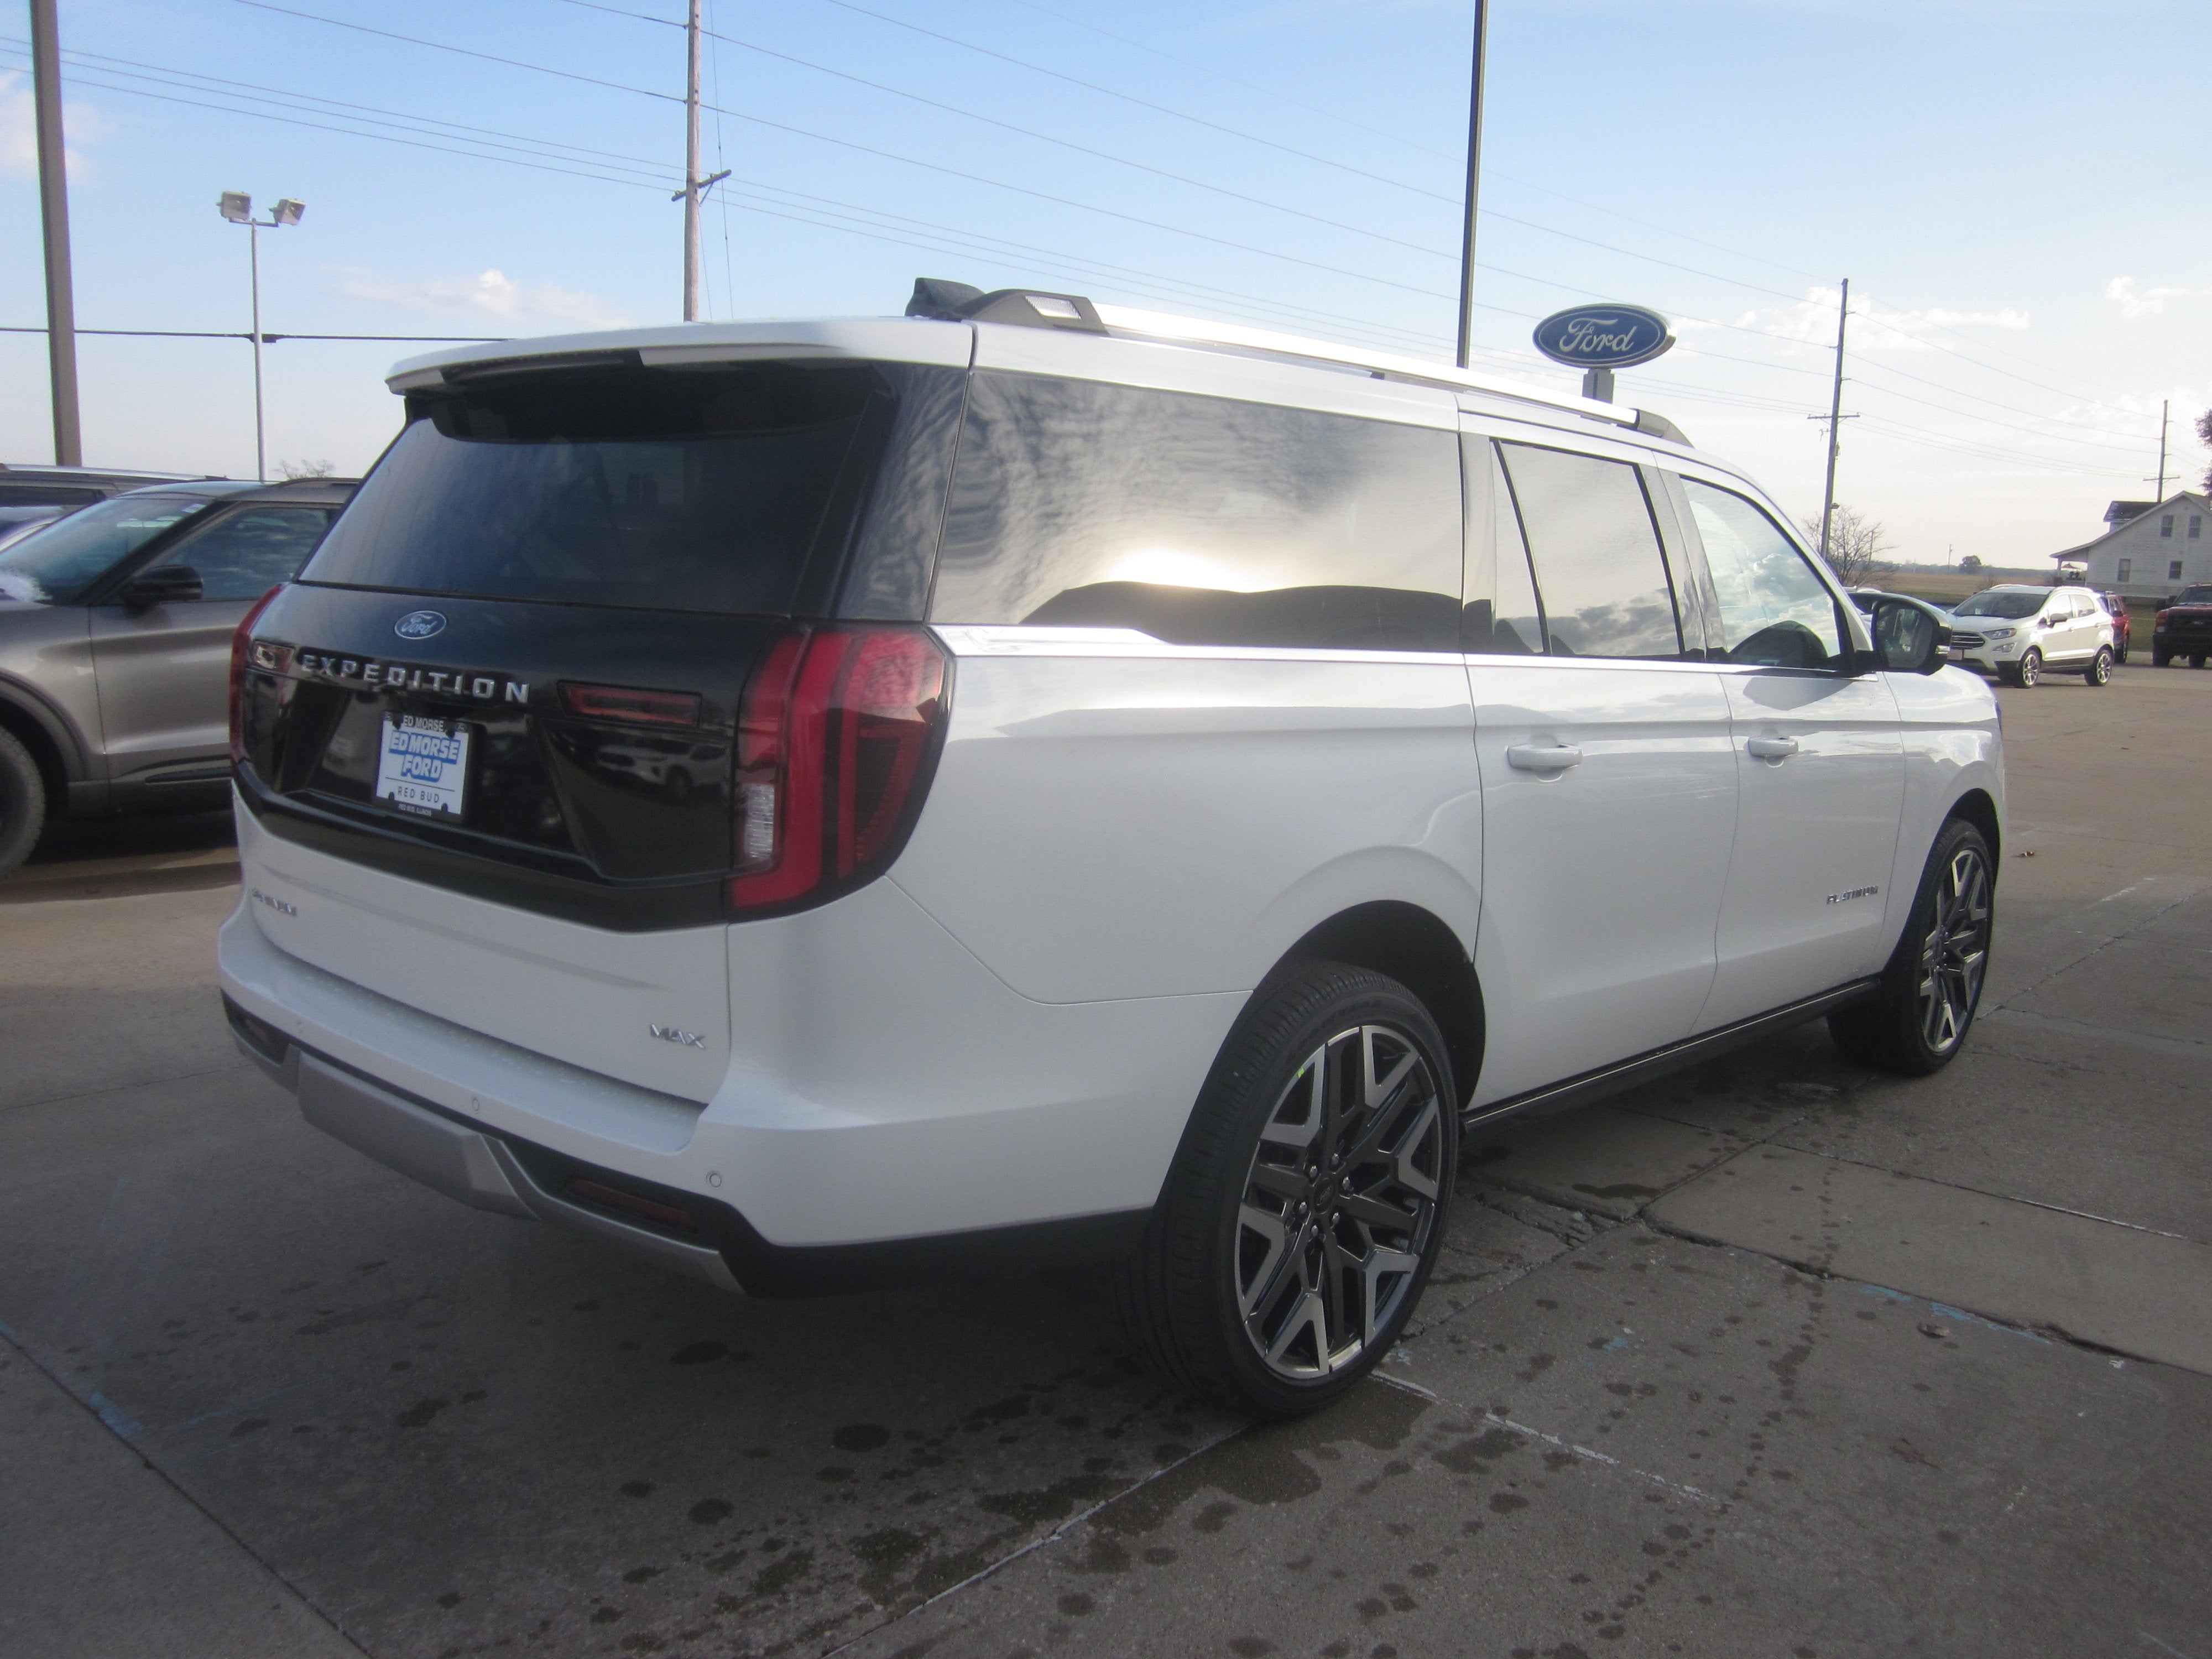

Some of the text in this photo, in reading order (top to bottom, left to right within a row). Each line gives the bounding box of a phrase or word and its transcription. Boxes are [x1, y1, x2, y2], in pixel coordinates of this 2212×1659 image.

[1559, 317, 1637, 352] Ford
[401, 613, 437, 634] Ford
[301, 654, 529, 703] EXPEDITION
[403, 715, 414, 727] ED
[416, 717, 444, 732] MORSE
[390, 732, 460, 760] ED MORSE
[403, 754, 442, 780] FORD
[398, 786, 440, 803] RED BUD
[650, 1024, 706, 1049] MAX
